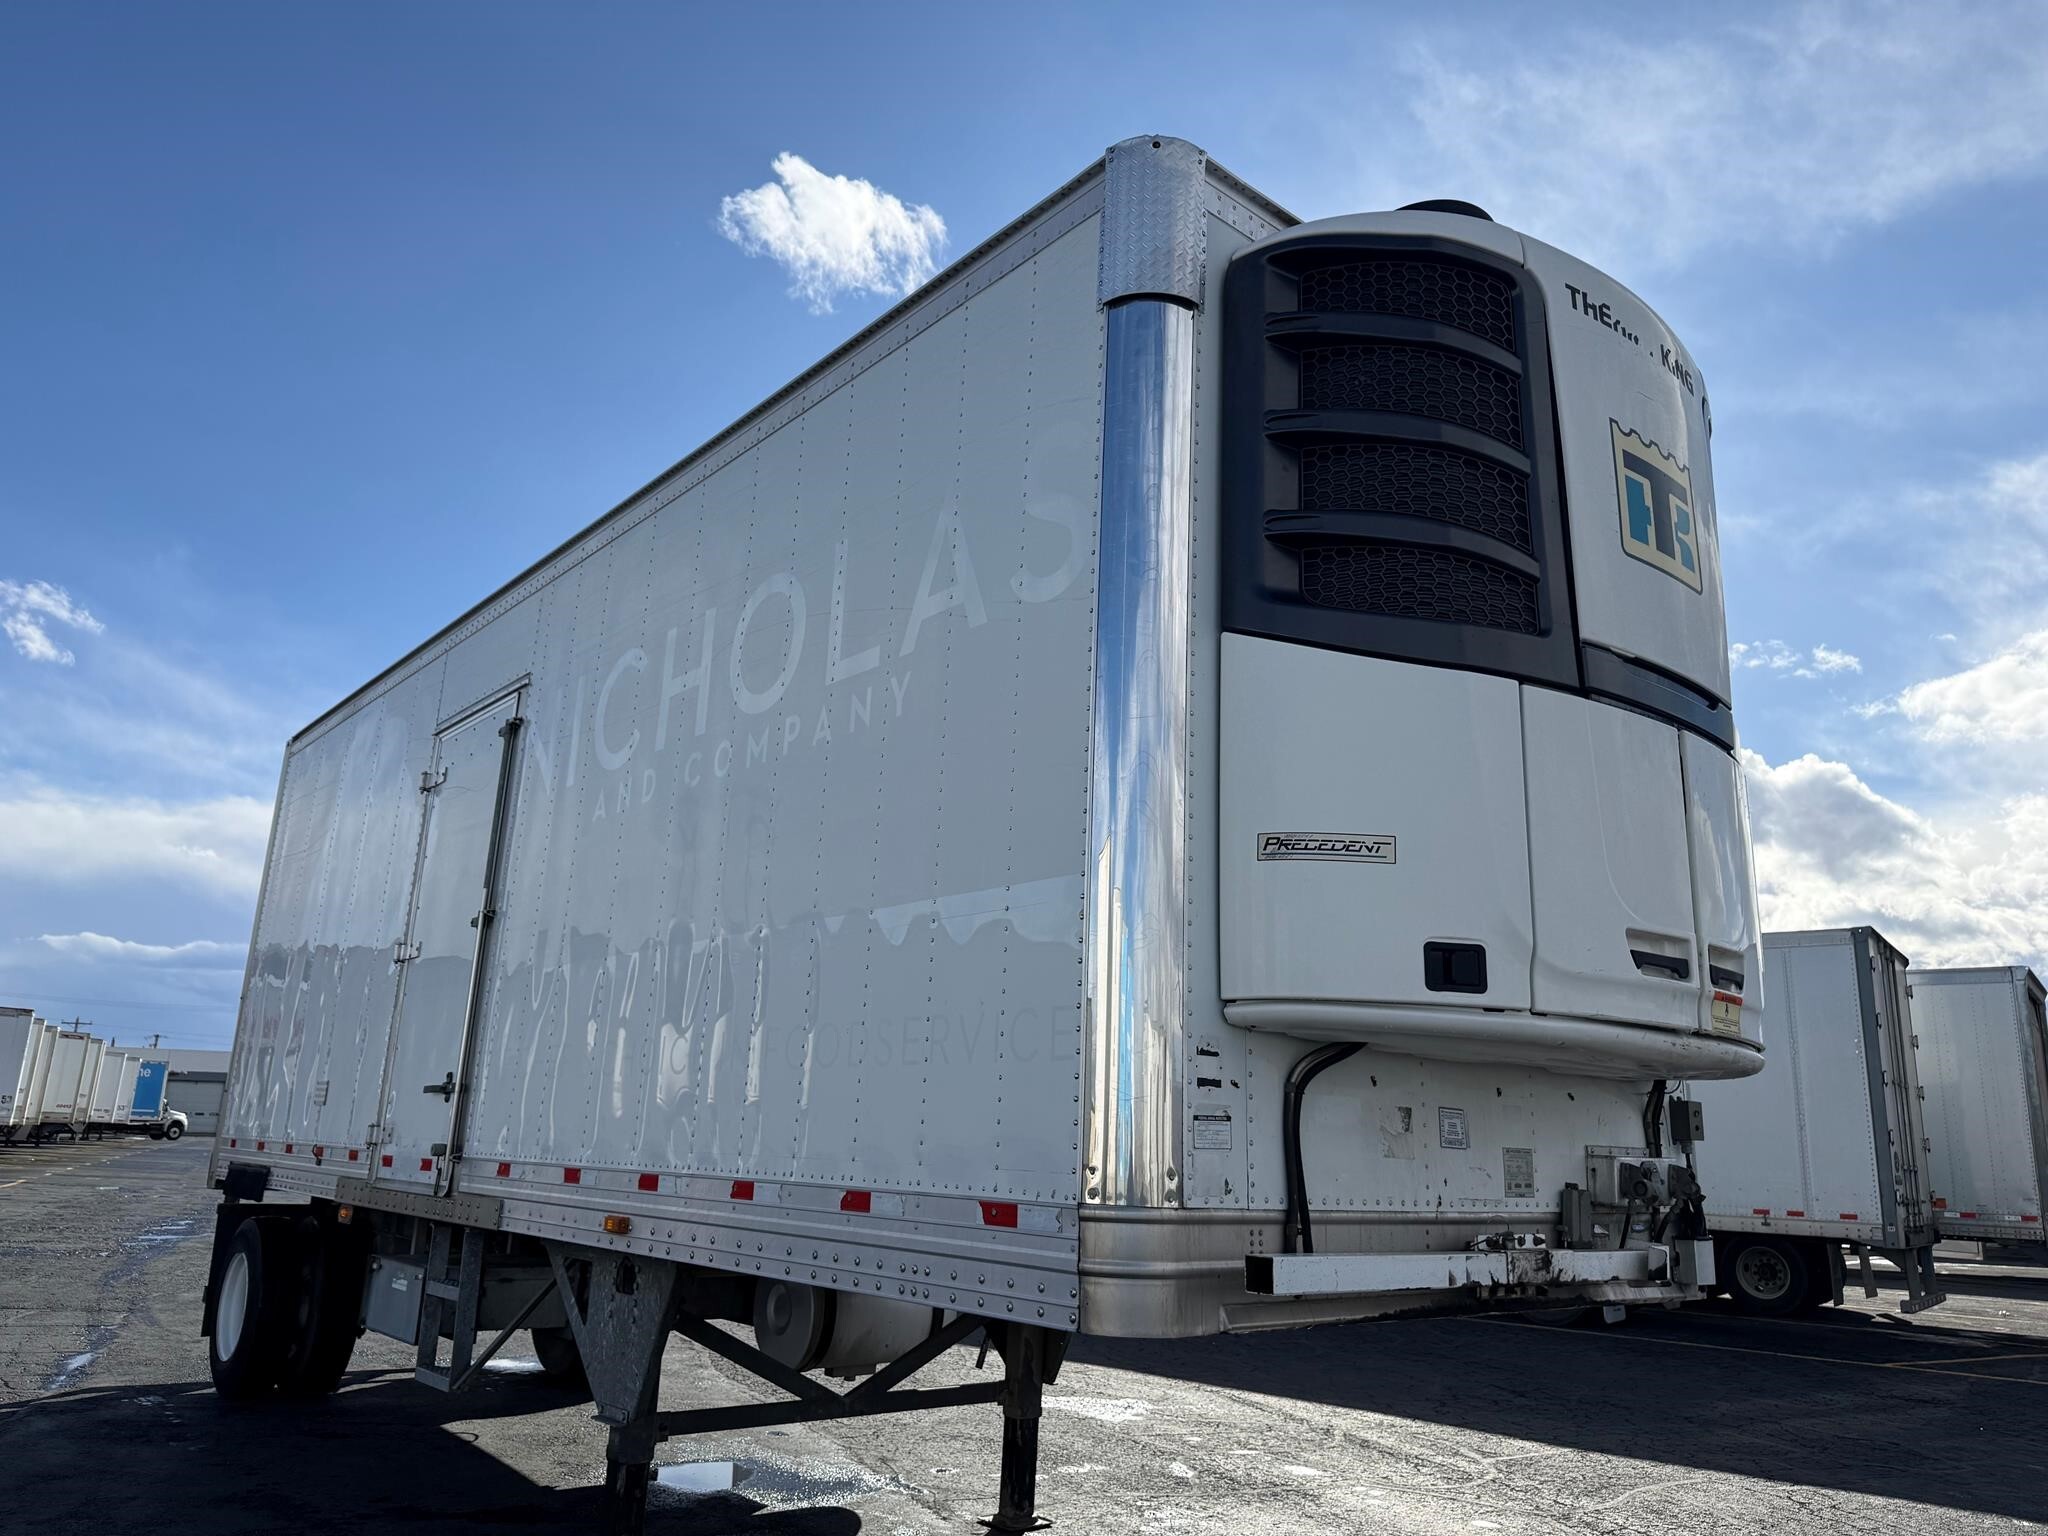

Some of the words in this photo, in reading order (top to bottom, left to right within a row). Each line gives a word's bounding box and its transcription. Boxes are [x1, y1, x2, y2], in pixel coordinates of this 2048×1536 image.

[518, 421, 1088, 802] NICHOLAS
[683, 670, 913, 787] COMPANY
[592, 766, 657, 822] AND
[1262, 836, 1392, 854] PRECEDENT
[763, 1005, 1079, 1070] FOODSERVICE
